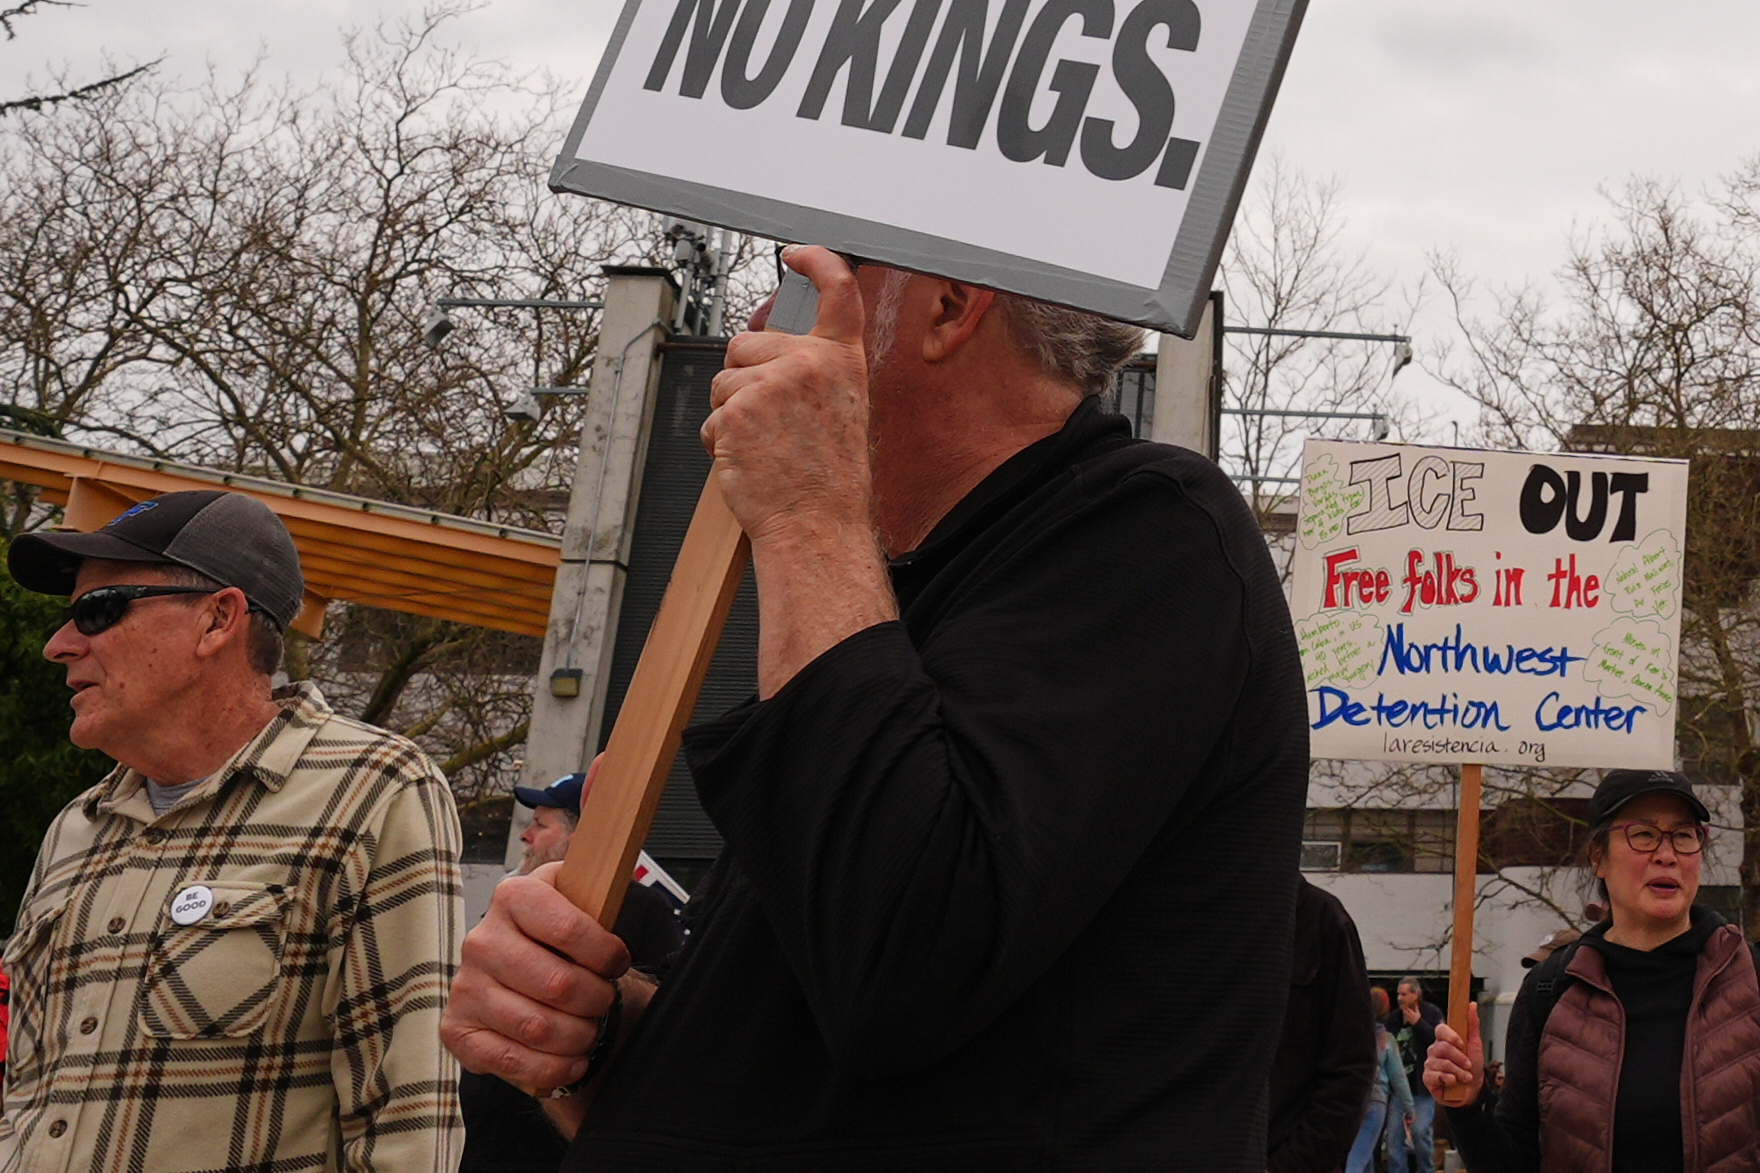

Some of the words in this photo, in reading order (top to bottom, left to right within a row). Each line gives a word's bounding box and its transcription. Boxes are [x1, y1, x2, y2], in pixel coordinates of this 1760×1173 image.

[1347, 453, 1484, 537] ICE
[1519, 463, 1650, 544] OUT
[1320, 546, 1391, 610] Free
[1401, 549, 1480, 615] folks
[1491, 551, 1526, 608] in
[1547, 553, 1601, 610] the
[1377, 623, 1588, 677] Northwest
[1309, 686, 1511, 732] Detention
[1535, 691, 1648, 734] Center
[1517, 739, 1547, 762] org
[176, 901, 206, 913] GOOD
[186, 892, 198, 900] BE
